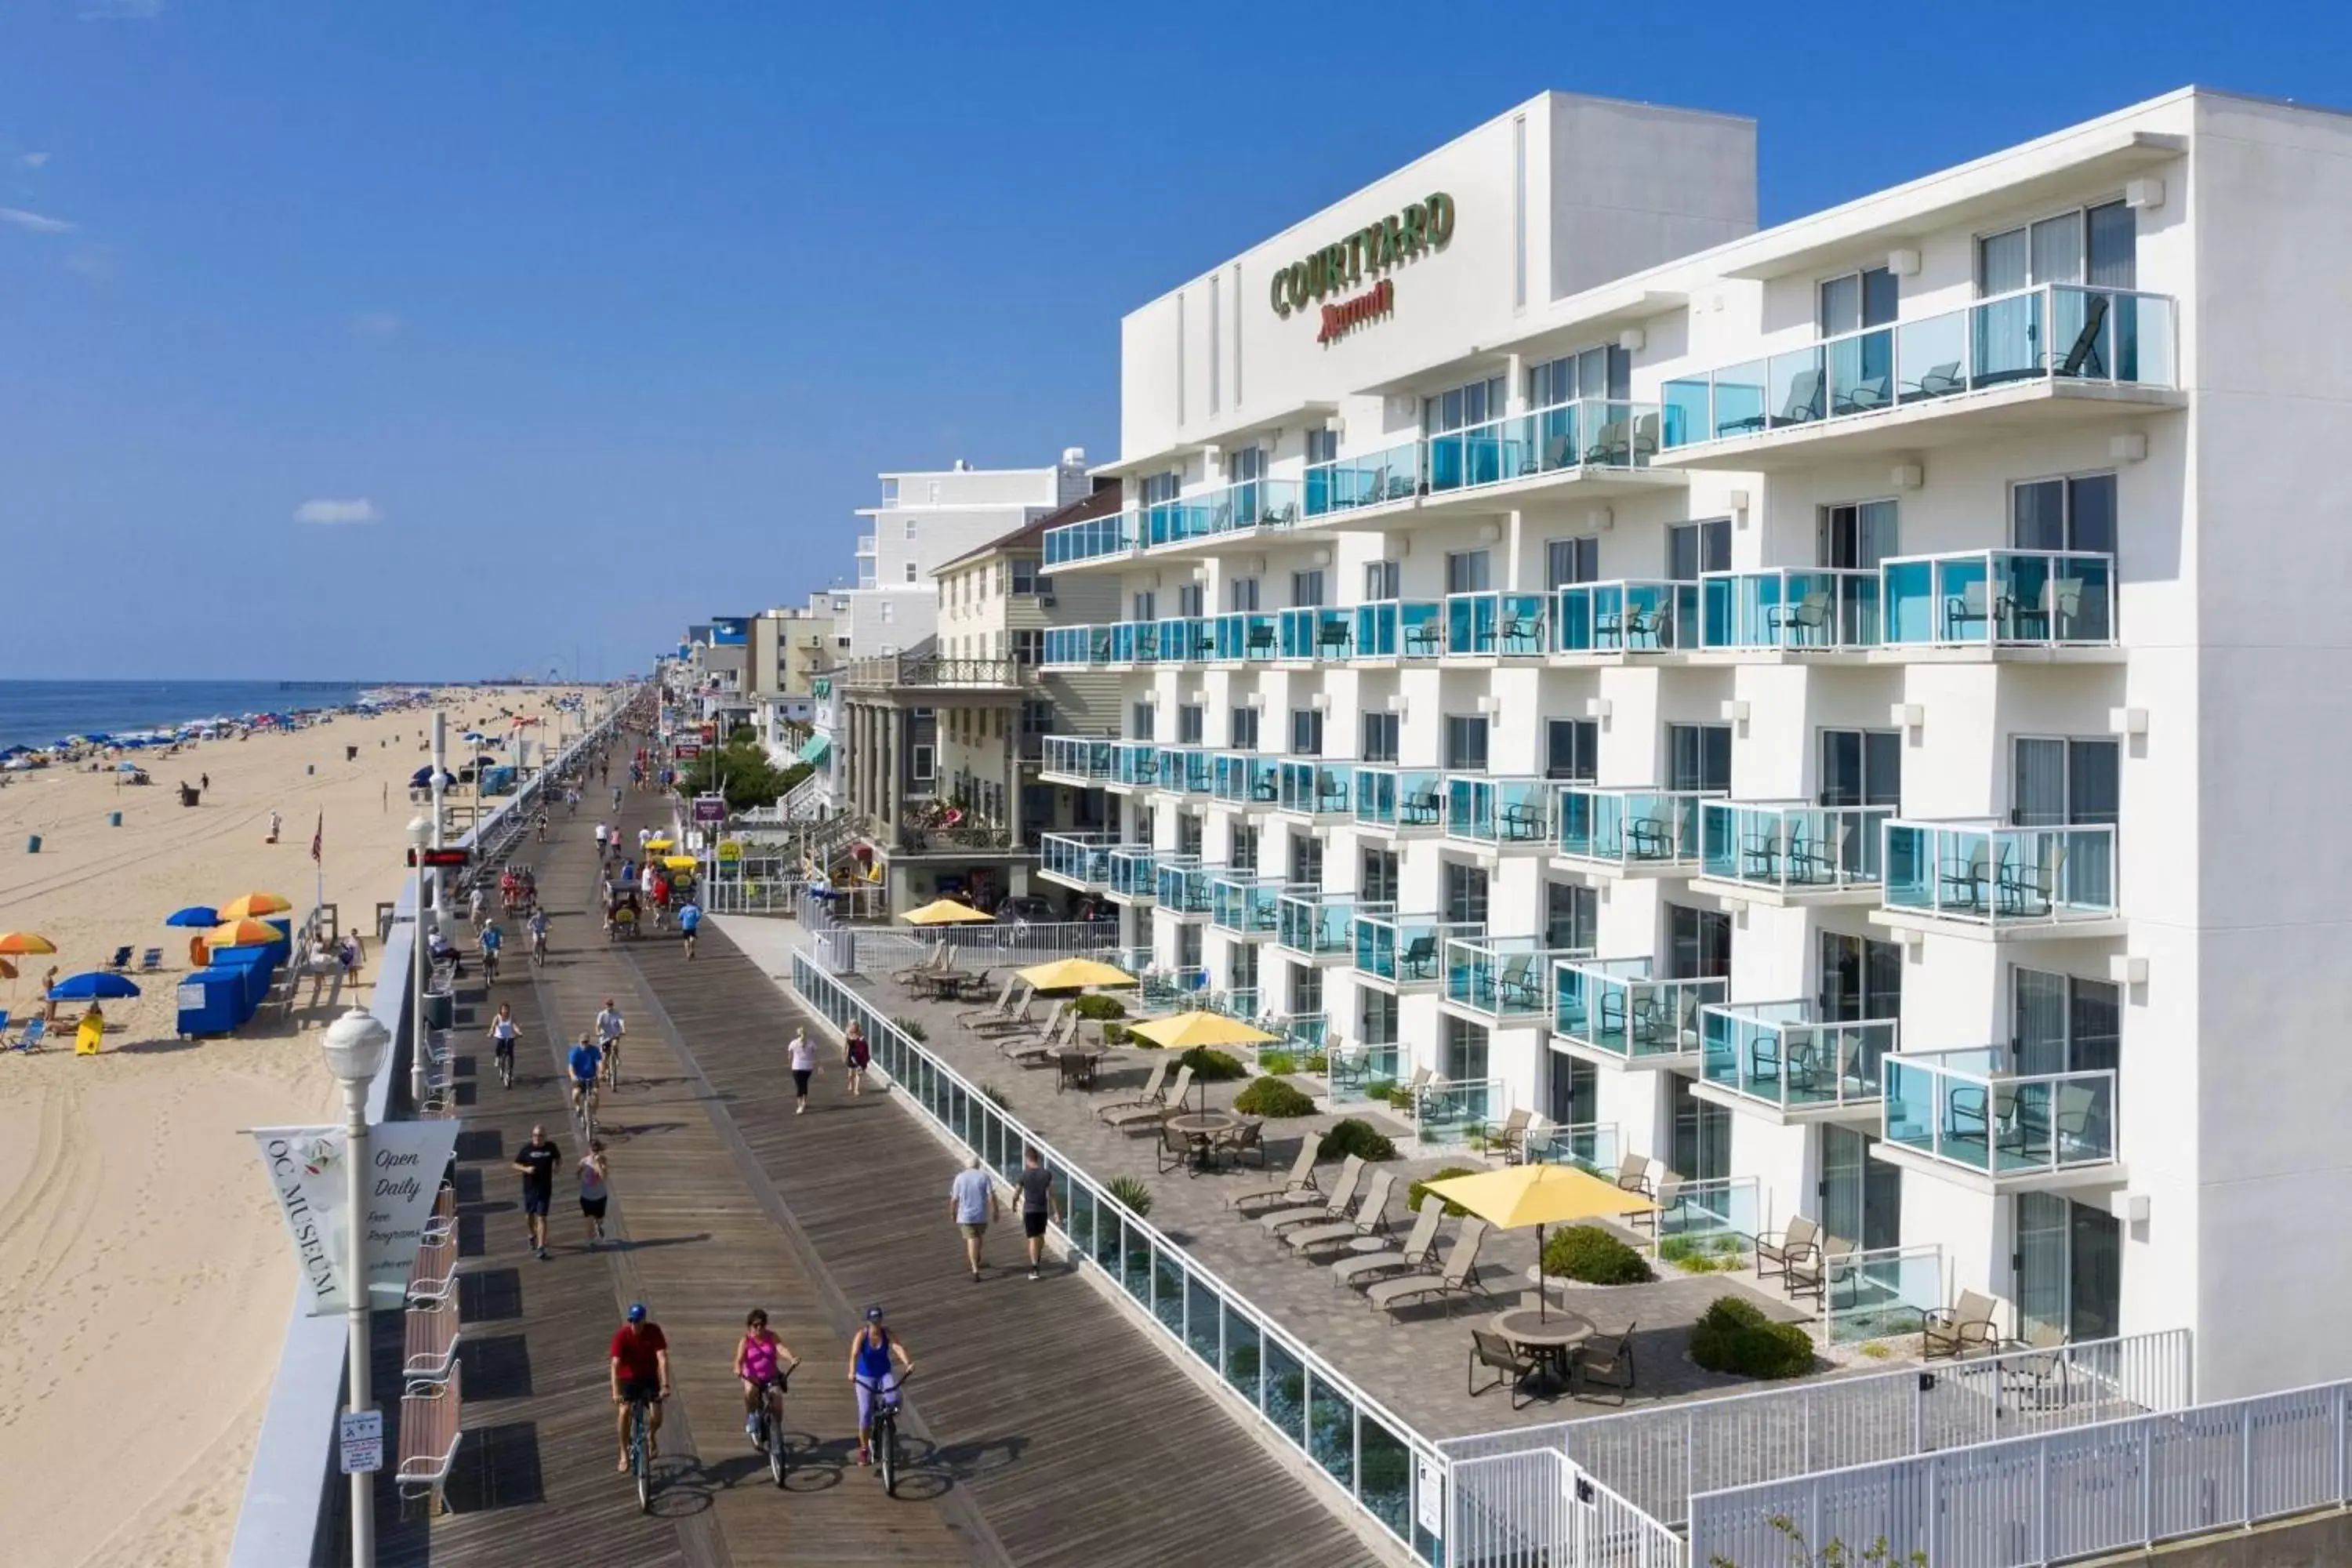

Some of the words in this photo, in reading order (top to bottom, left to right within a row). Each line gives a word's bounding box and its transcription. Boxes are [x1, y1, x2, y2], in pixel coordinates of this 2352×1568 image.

[1270, 191, 1455, 317] COURTYARD
[374, 1176, 421, 1203] Daily
[376, 1149, 419, 1171] Open
[268, 1139, 295, 1178] OC
[282, 1183, 336, 1298] MUSEUM
